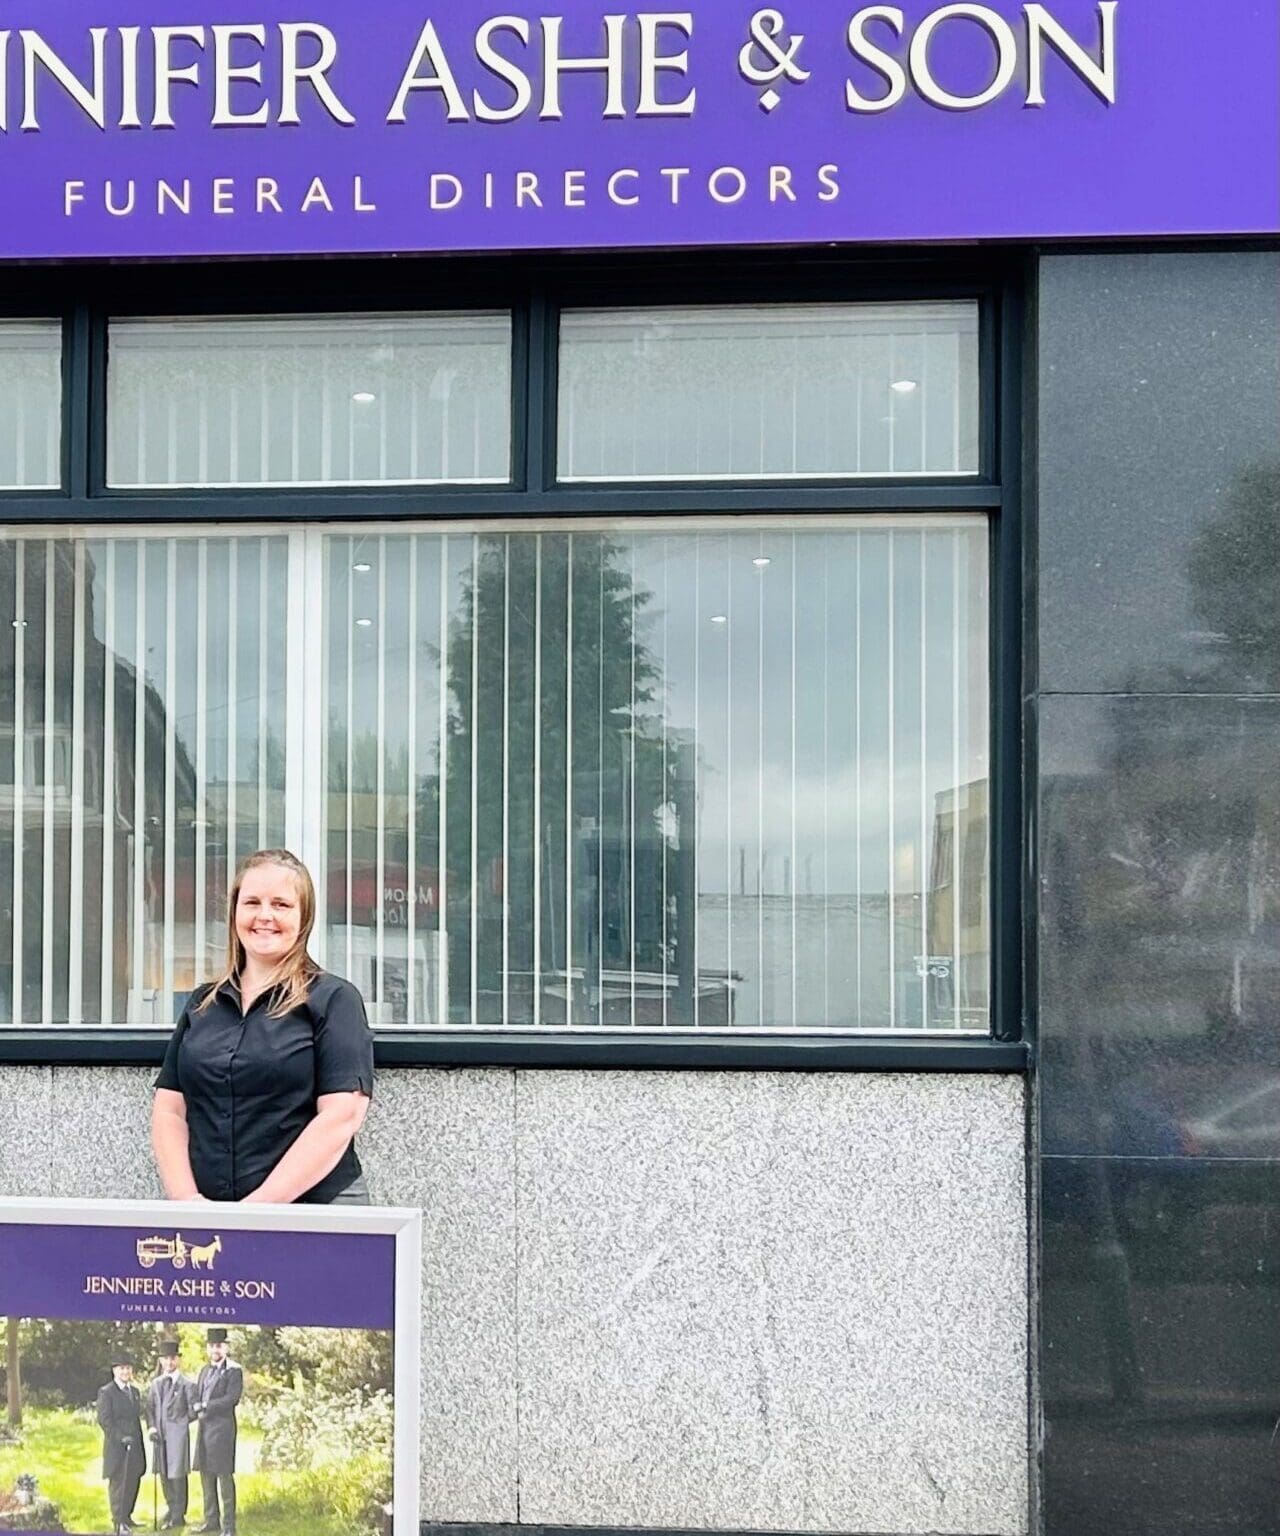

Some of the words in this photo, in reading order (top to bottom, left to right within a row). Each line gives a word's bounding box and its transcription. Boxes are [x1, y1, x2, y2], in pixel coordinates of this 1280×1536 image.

[385, 11, 697, 121] ASHE
[738, 8, 811, 113] &
[845, 0, 1120, 112] SON
[64, 175, 377, 217] FUNERAL
[429, 163, 841, 211] DIRECTORS
[83, 1276, 166, 1296] JENNIFER
[169, 1278, 216, 1297] ASHE
[220, 1280, 231, 1297] &
[234, 1280, 276, 1299] SON
[121, 1304, 169, 1313] FUNERAL
[175, 1306, 236, 1315] DIRECTORS
